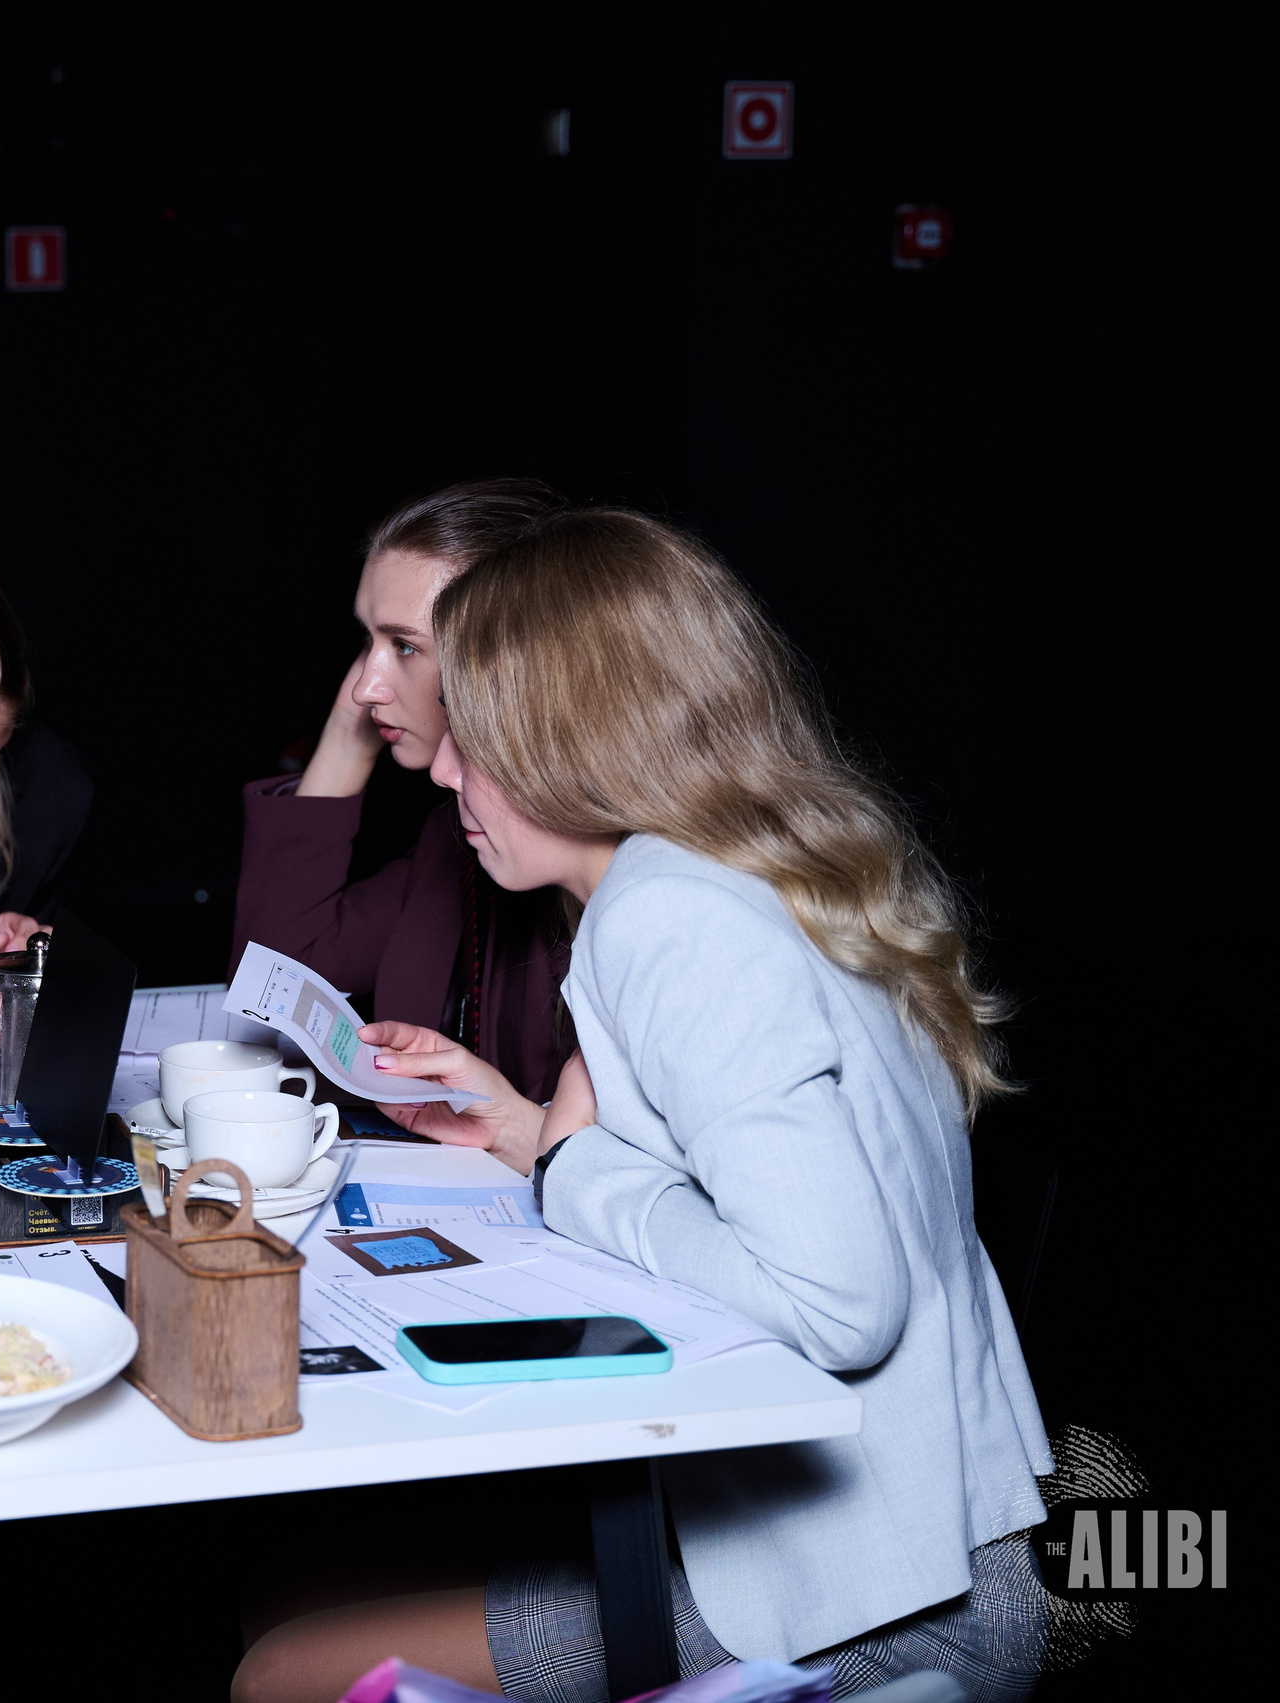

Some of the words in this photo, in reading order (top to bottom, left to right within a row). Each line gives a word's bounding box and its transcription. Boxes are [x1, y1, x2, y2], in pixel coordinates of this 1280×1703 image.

[241, 1008, 271, 1022] 2
[28, 1208, 50, 1217] Счёт.
[28, 1217, 61, 1225] Чаевые.
[28, 1226, 57, 1234] Отзыв.
[38, 1249, 71, 1259] 3
